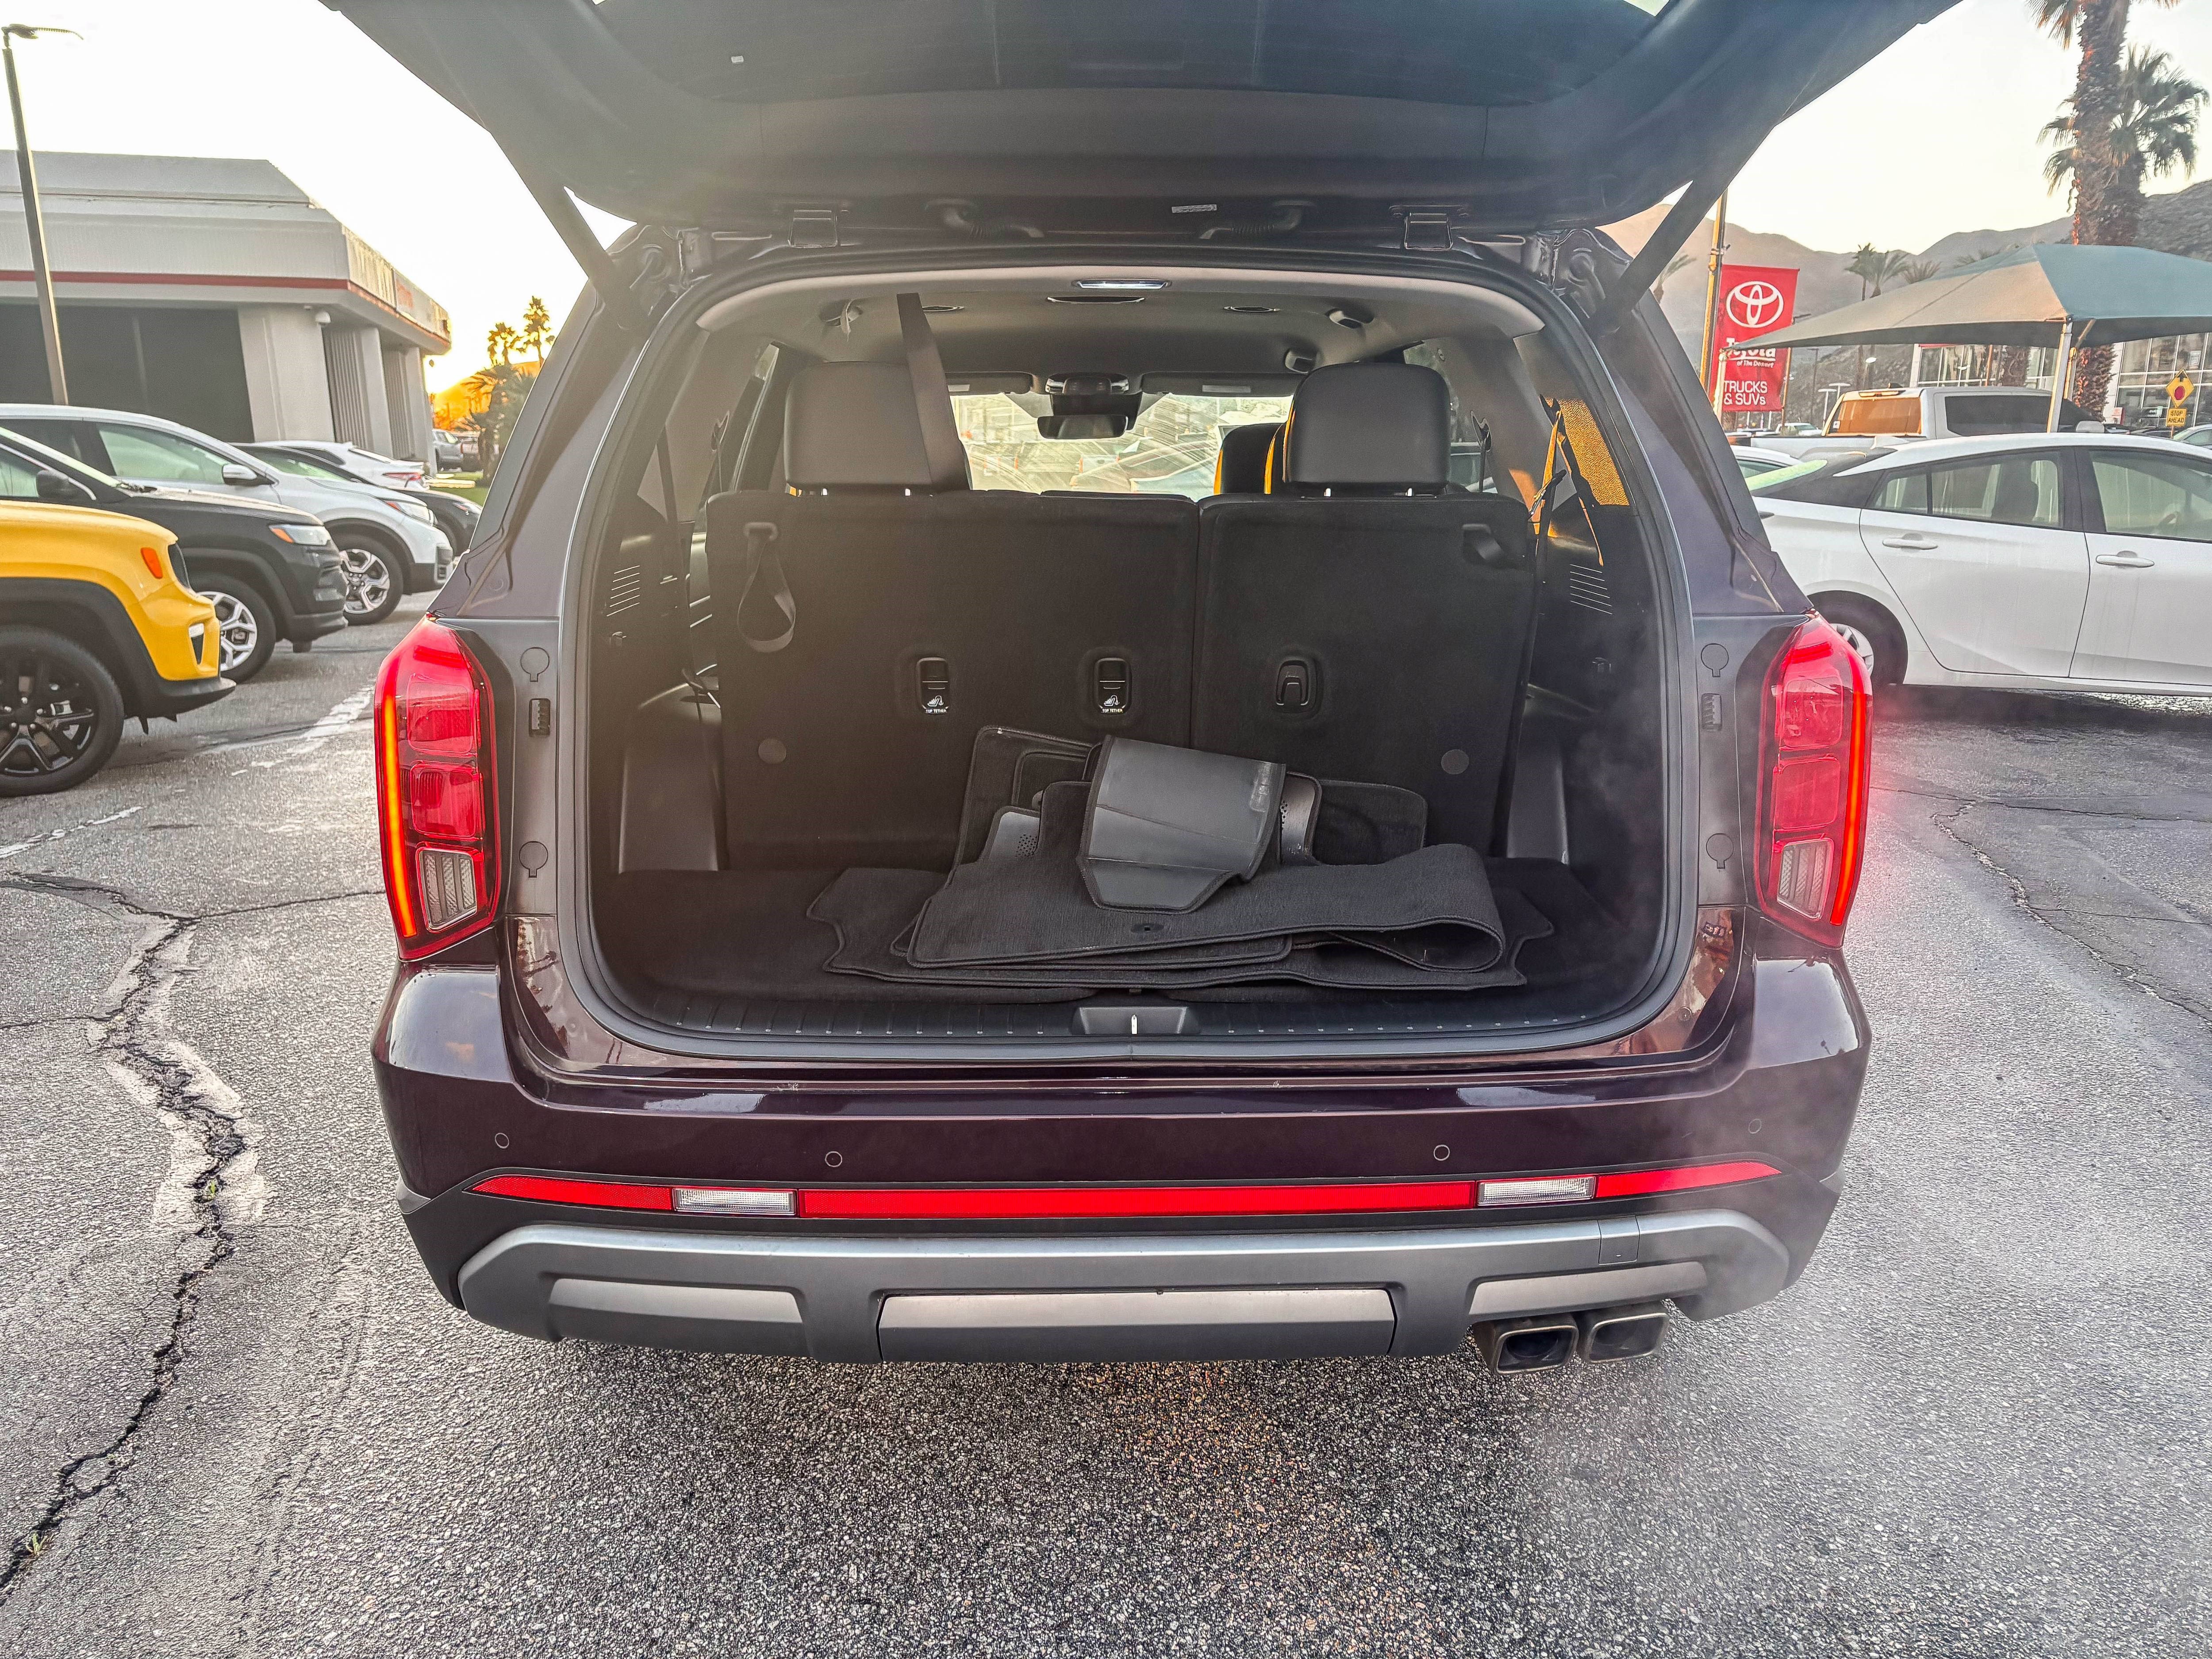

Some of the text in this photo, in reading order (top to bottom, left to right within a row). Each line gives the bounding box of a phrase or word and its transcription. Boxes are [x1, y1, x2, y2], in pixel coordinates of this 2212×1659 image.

[1724, 380, 1768, 394] TRUCKS
[1724, 393, 1766, 405] & SUVs
